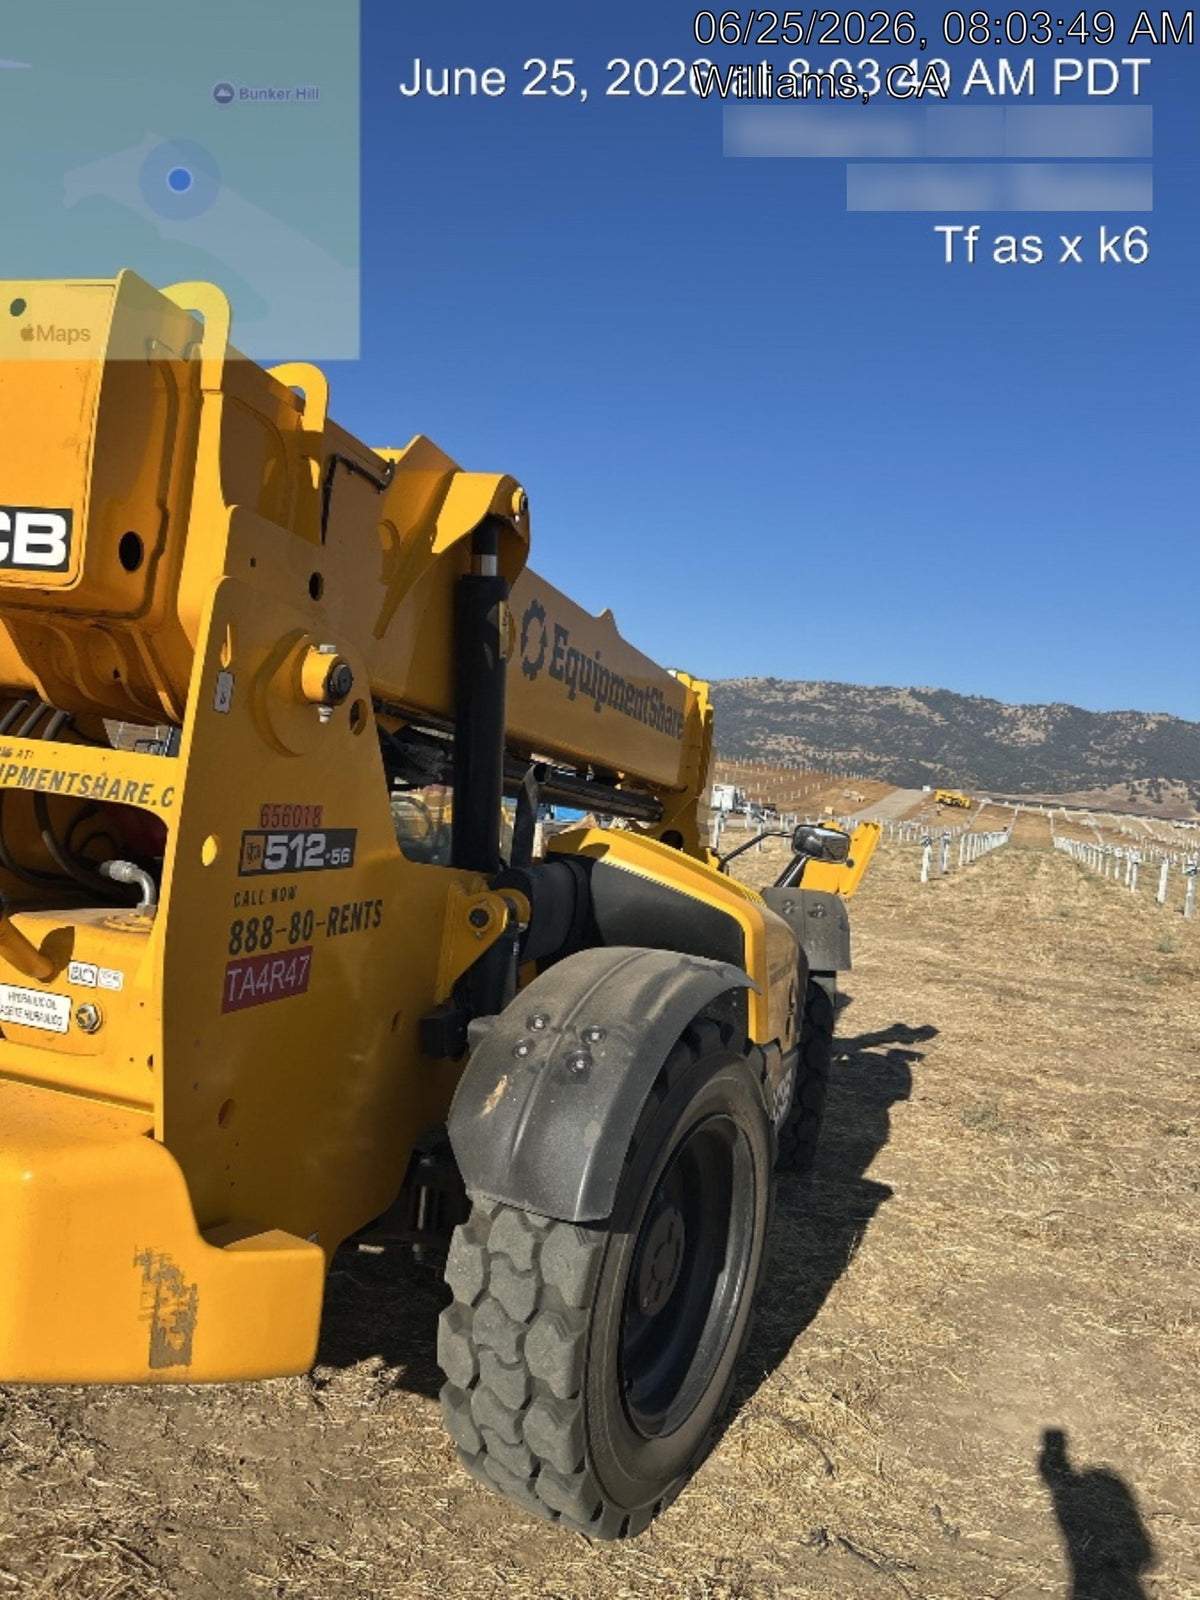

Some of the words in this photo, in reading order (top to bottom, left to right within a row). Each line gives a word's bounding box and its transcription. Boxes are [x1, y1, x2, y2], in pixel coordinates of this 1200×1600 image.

[0, 511, 67, 567] B
[549, 622, 685, 741] EquipmentShare
[234, 888, 264, 908] CALL
[271, 885, 298, 902] NOW
[229, 899, 384, 955] 888-80-RENTS
[227, 955, 310, 1002] TA4R47
